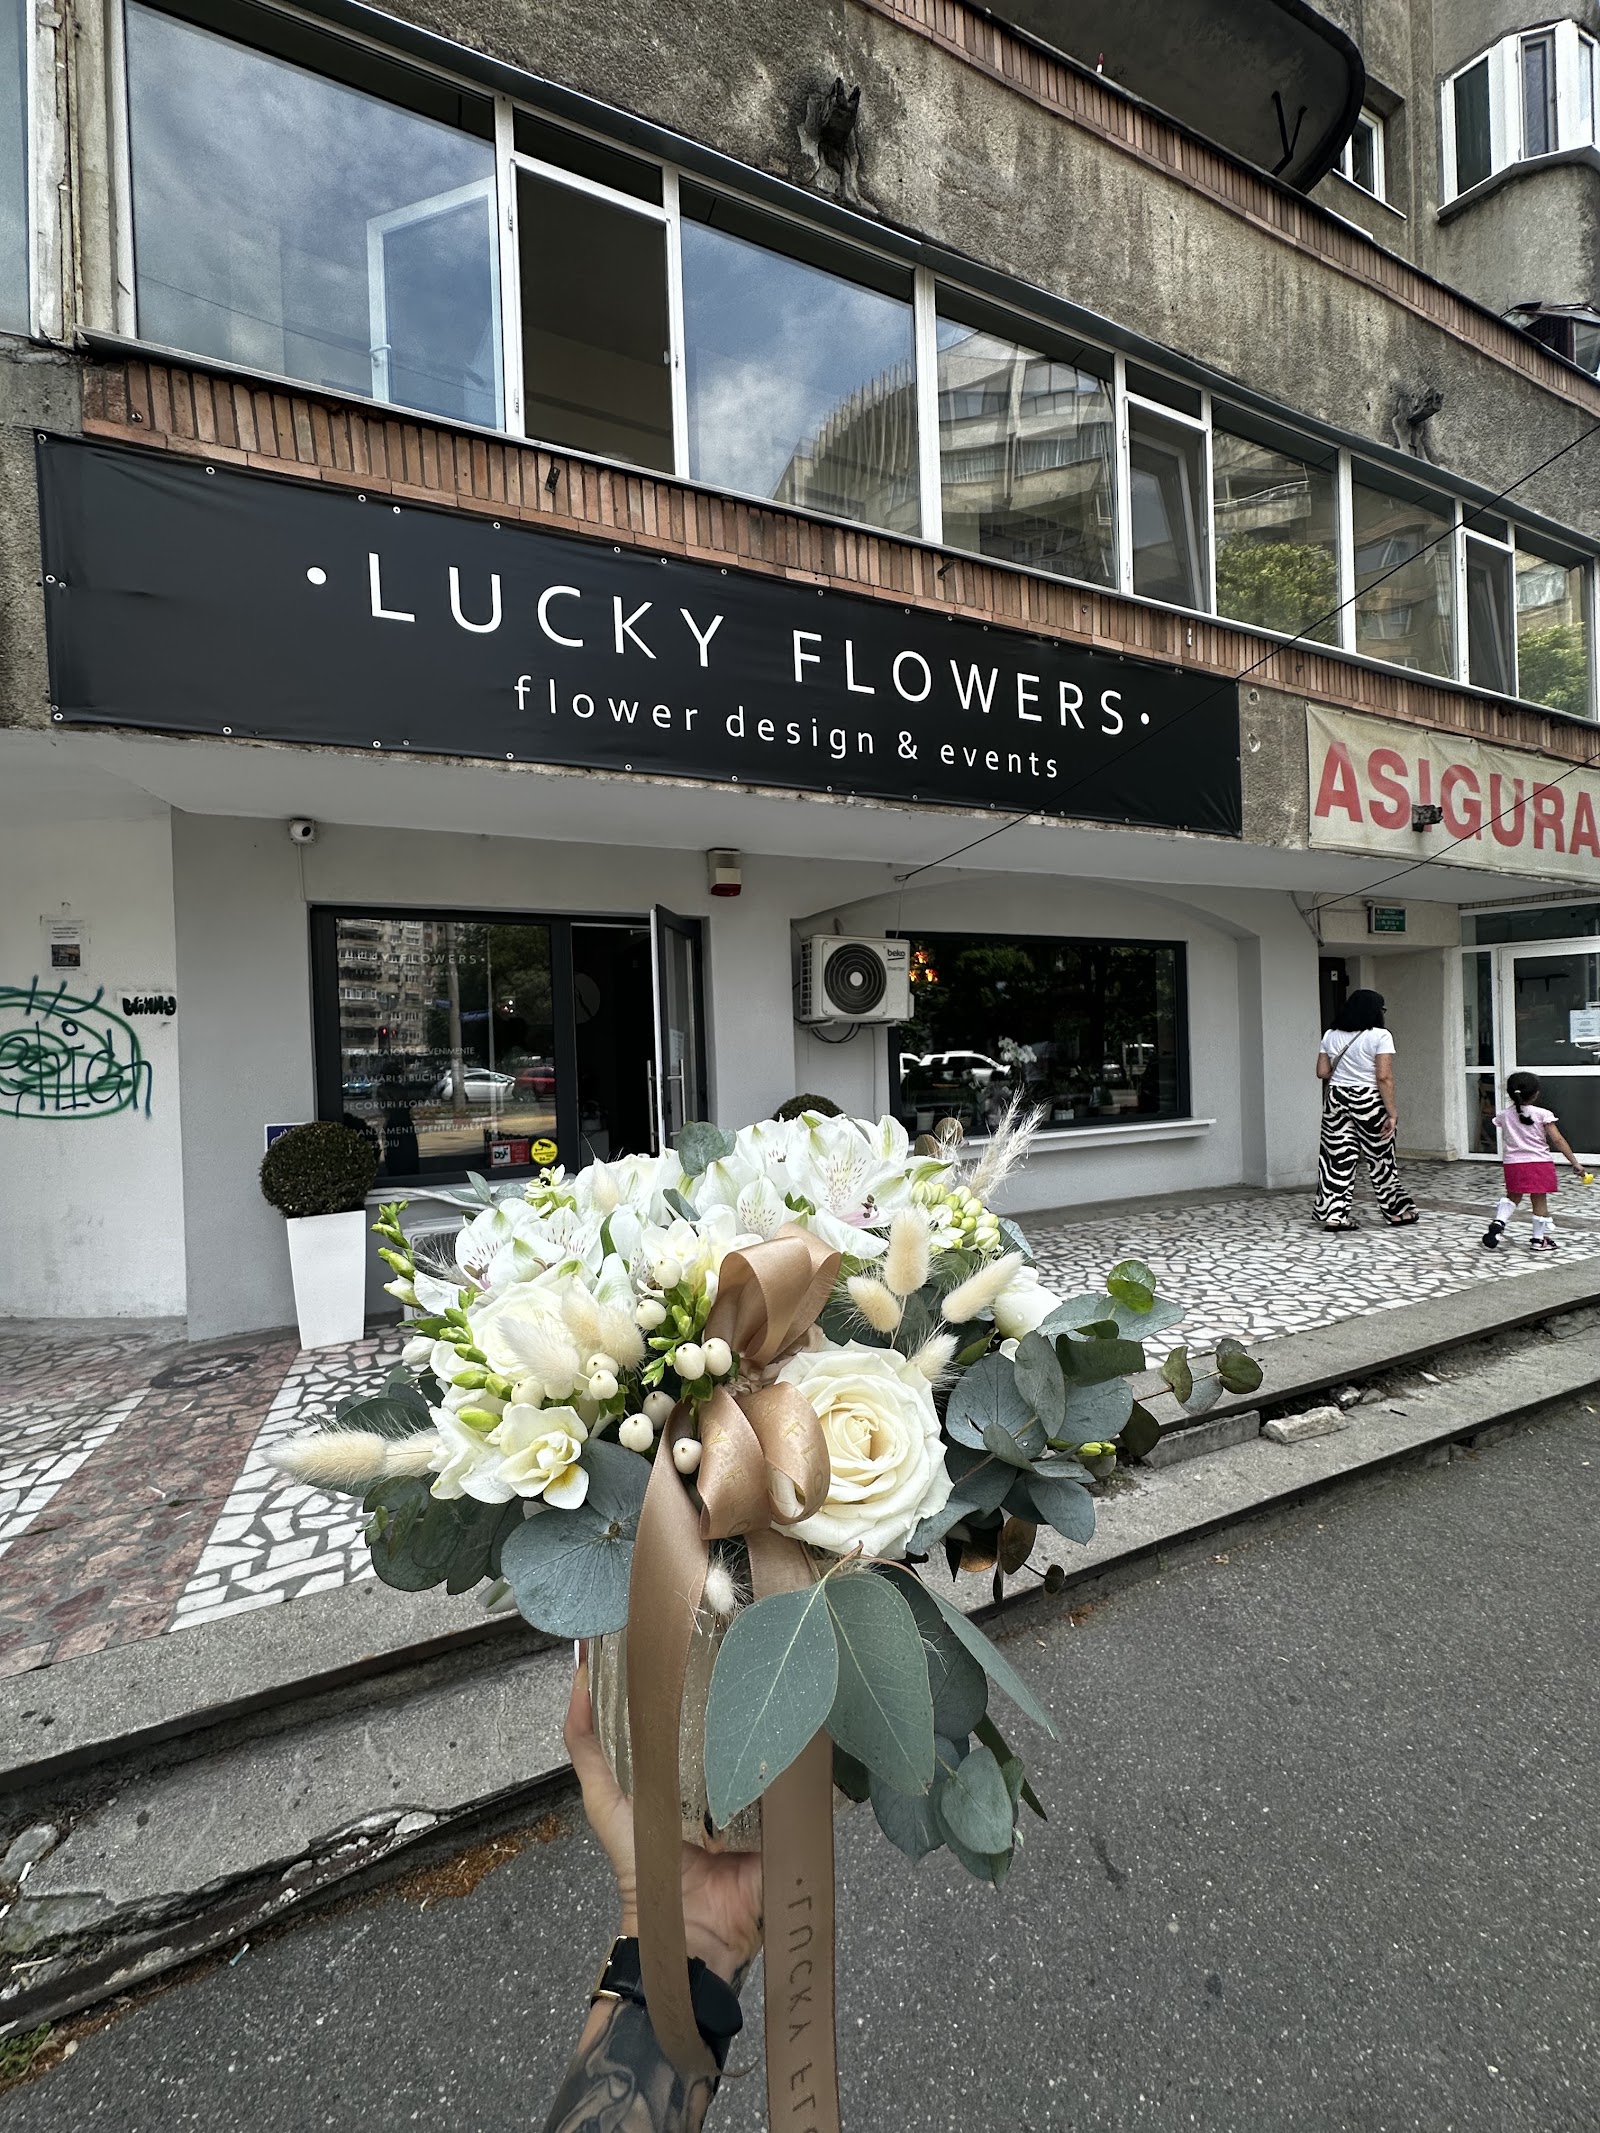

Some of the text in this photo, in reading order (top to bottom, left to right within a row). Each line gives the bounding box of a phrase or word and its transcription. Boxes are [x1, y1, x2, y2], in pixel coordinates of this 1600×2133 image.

[368, 552, 1125, 736] LUCKY FLOWERS
[513, 674, 1059, 778] flower design & events
[887, 949, 906, 957] beko
[355, 1126, 420, 1137] ANJAMENTE
